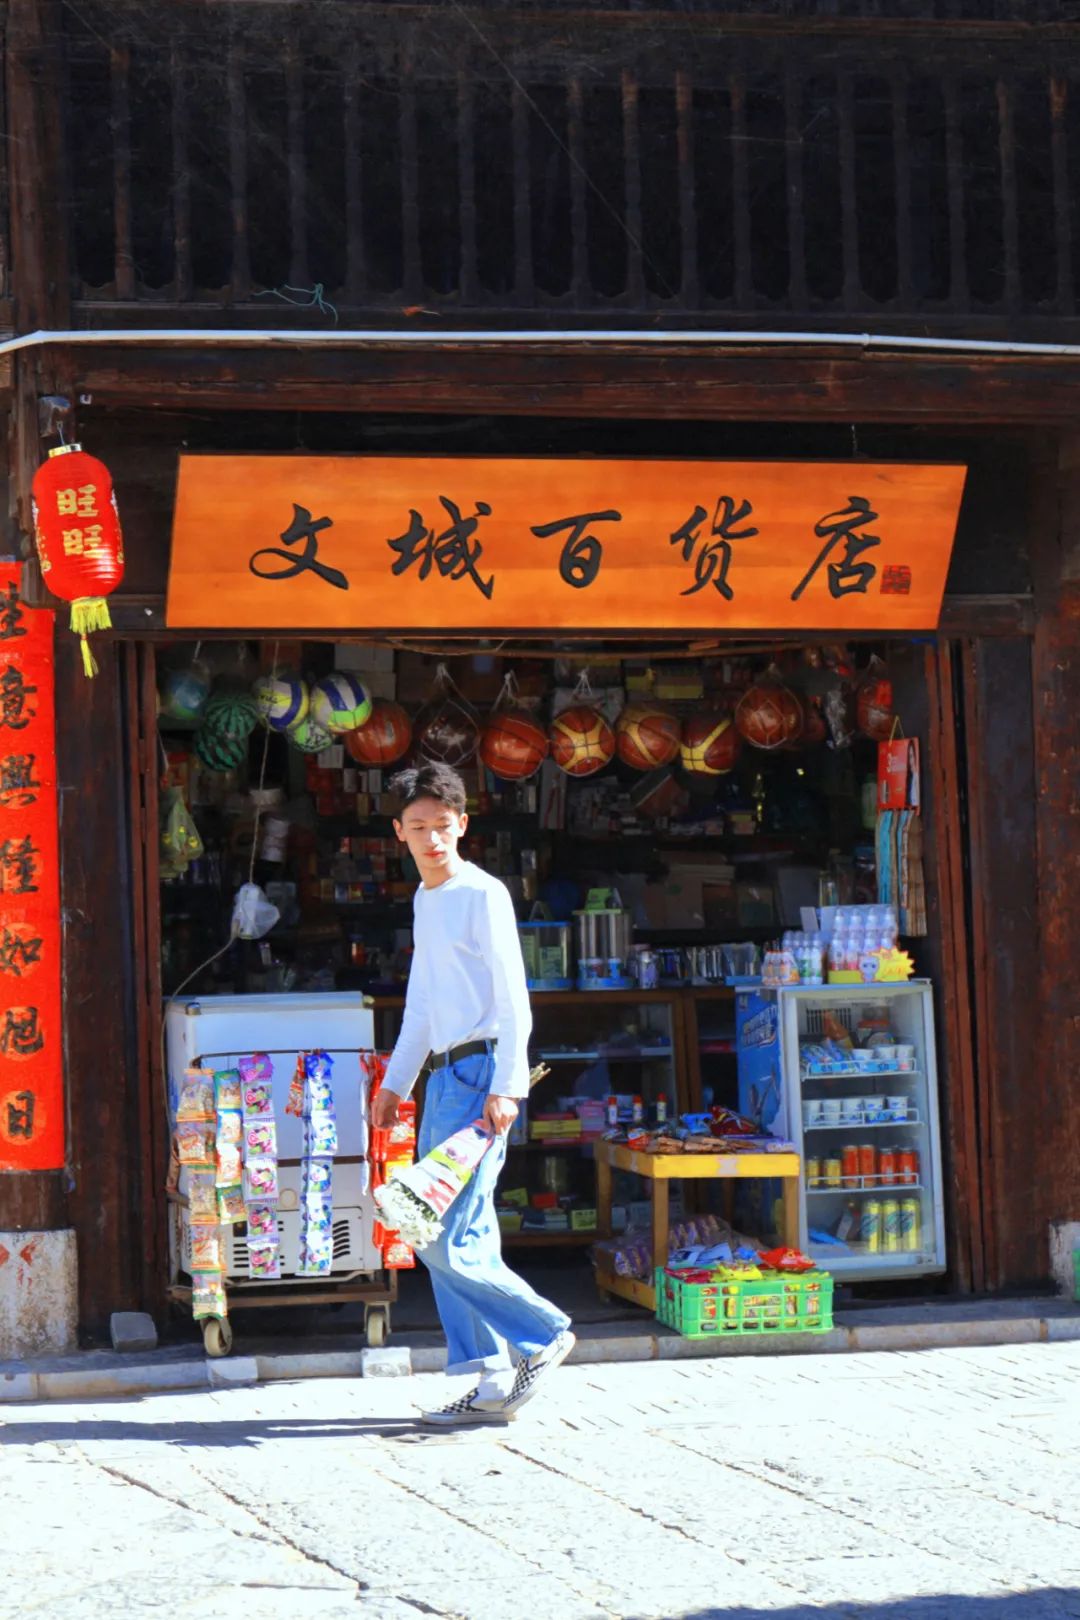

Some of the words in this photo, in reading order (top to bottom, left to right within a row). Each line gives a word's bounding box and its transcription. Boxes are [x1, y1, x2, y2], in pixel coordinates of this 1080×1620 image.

[57, 484, 104, 558] 旺旺
[249, 495, 881, 600] 文城百货店
